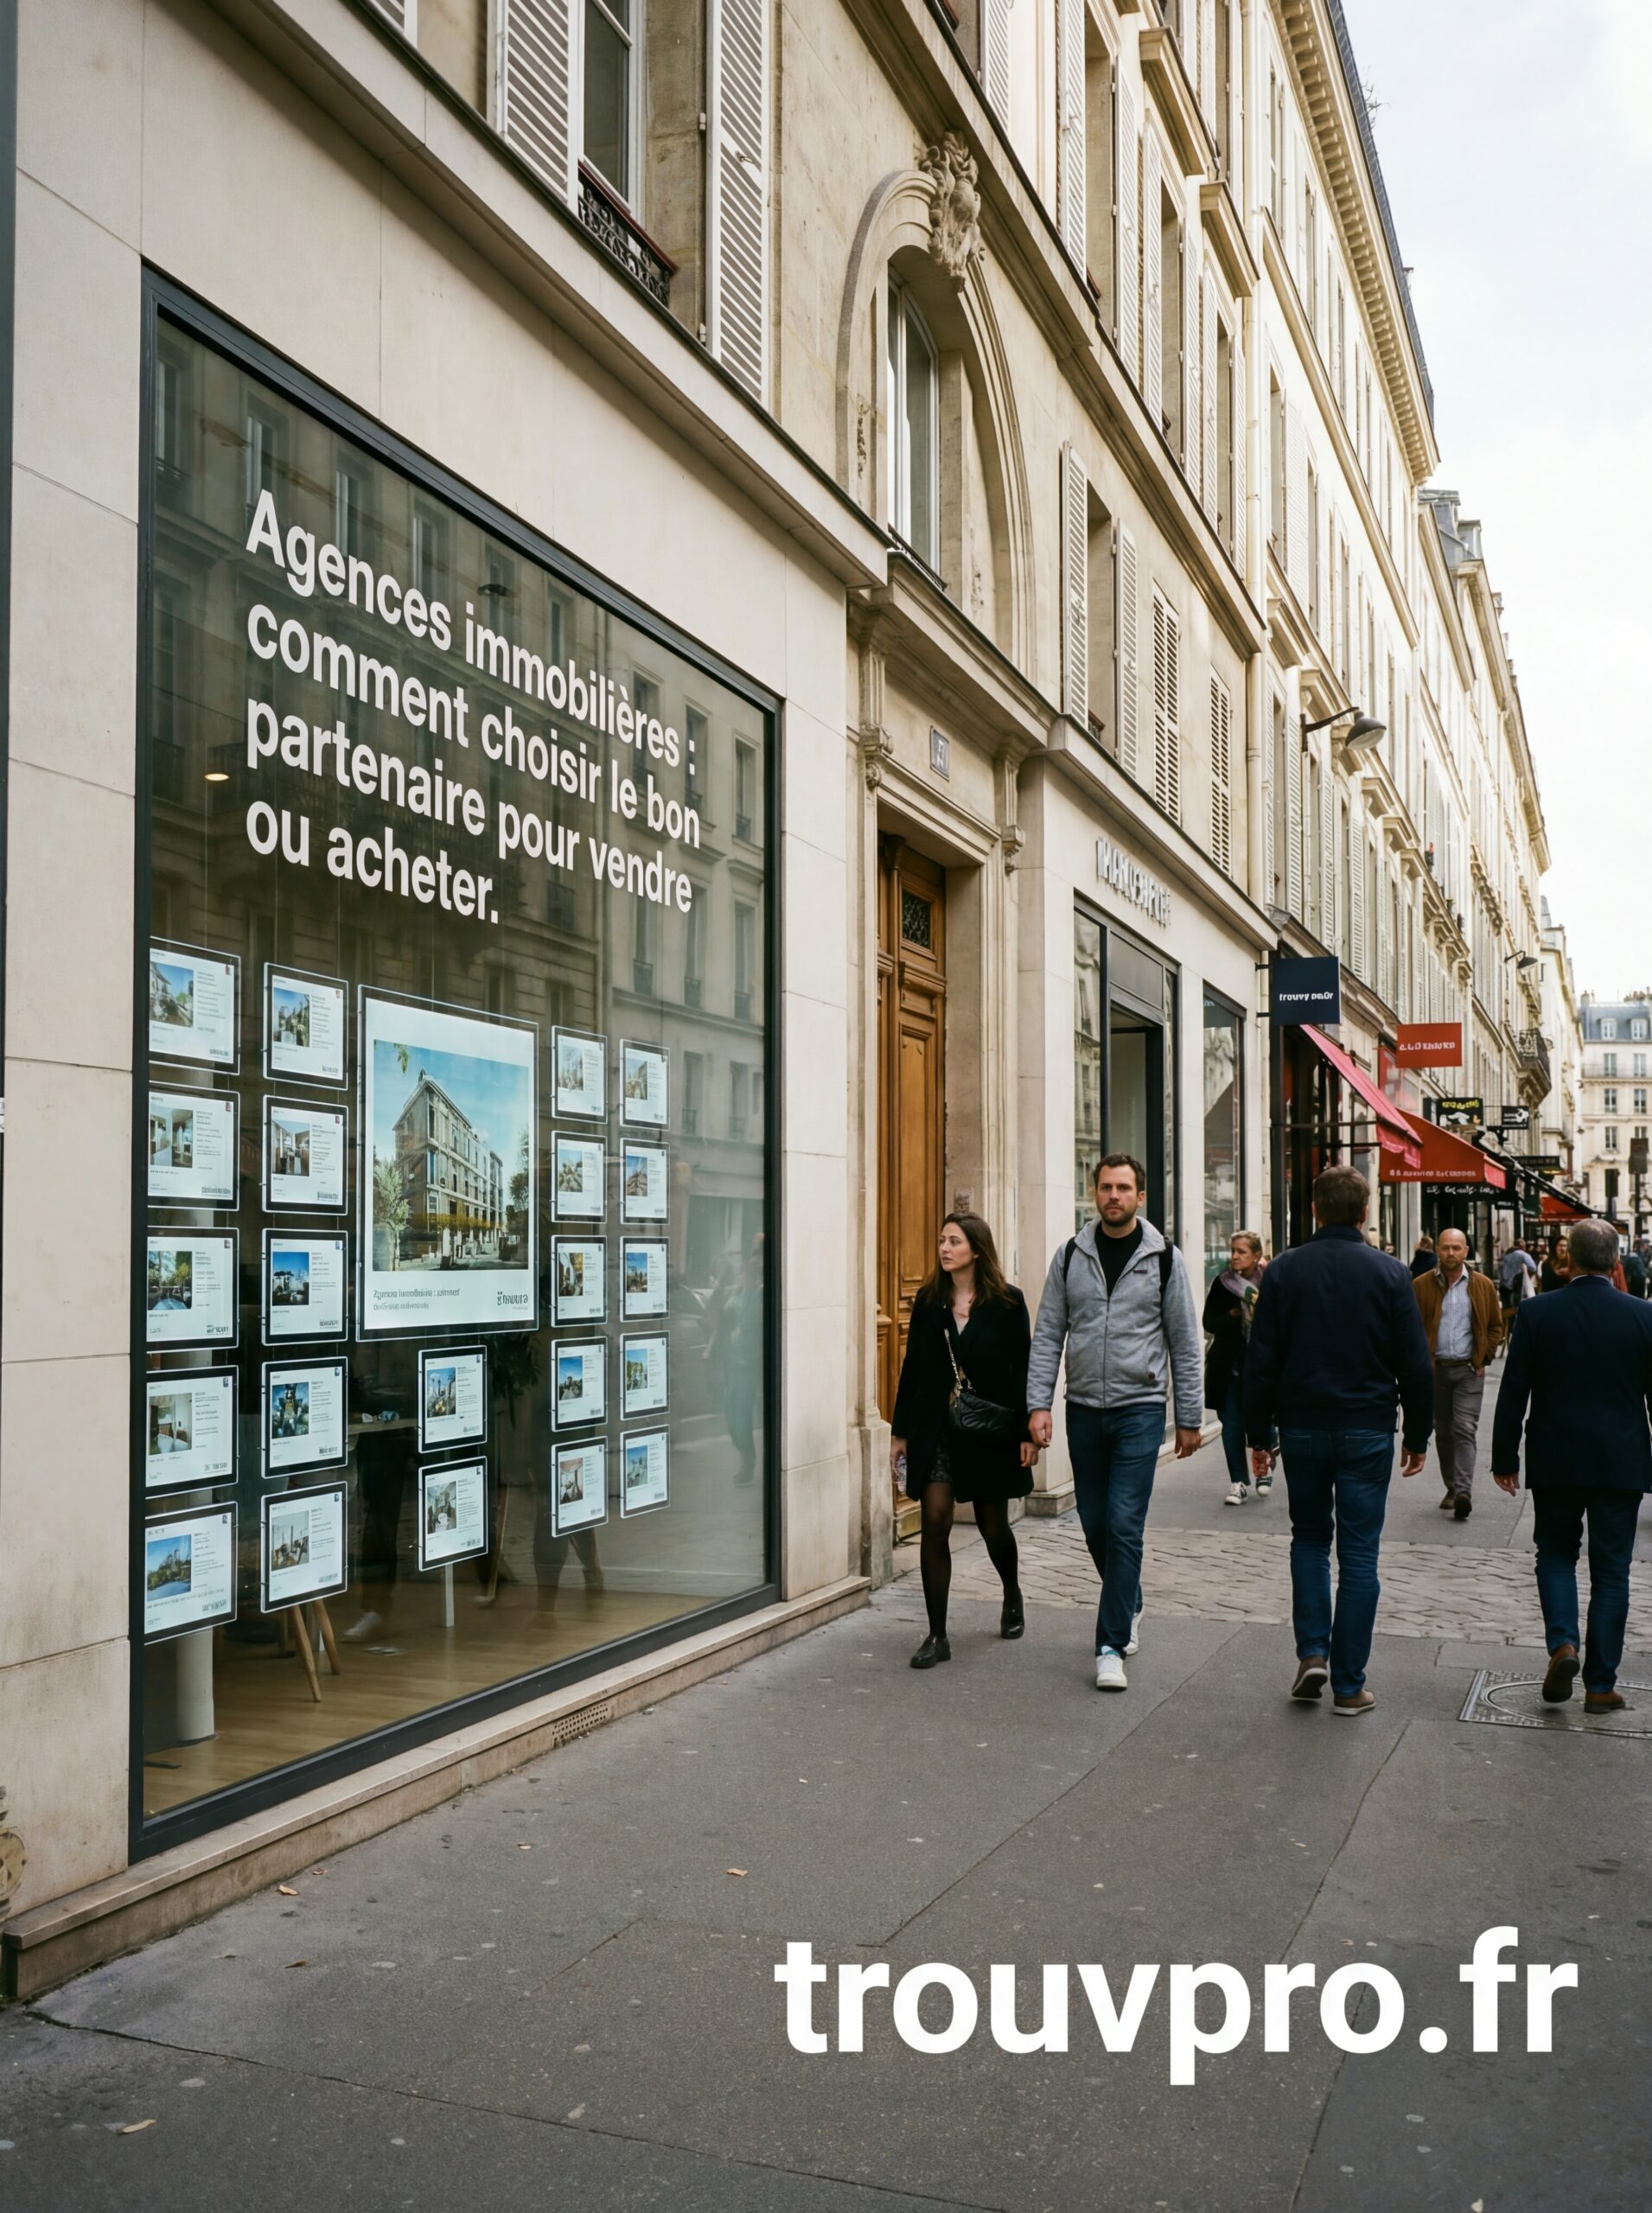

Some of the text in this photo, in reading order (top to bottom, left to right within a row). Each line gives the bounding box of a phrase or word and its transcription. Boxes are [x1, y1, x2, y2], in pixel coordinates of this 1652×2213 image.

[246, 488, 451, 651] Agences
[465, 601, 680, 768] immobilières
[247, 604, 700, 849] comment choisir le bon
[246, 800, 499, 924] ou acheter.
[247, 698, 692, 914] partenaire pour vendre
